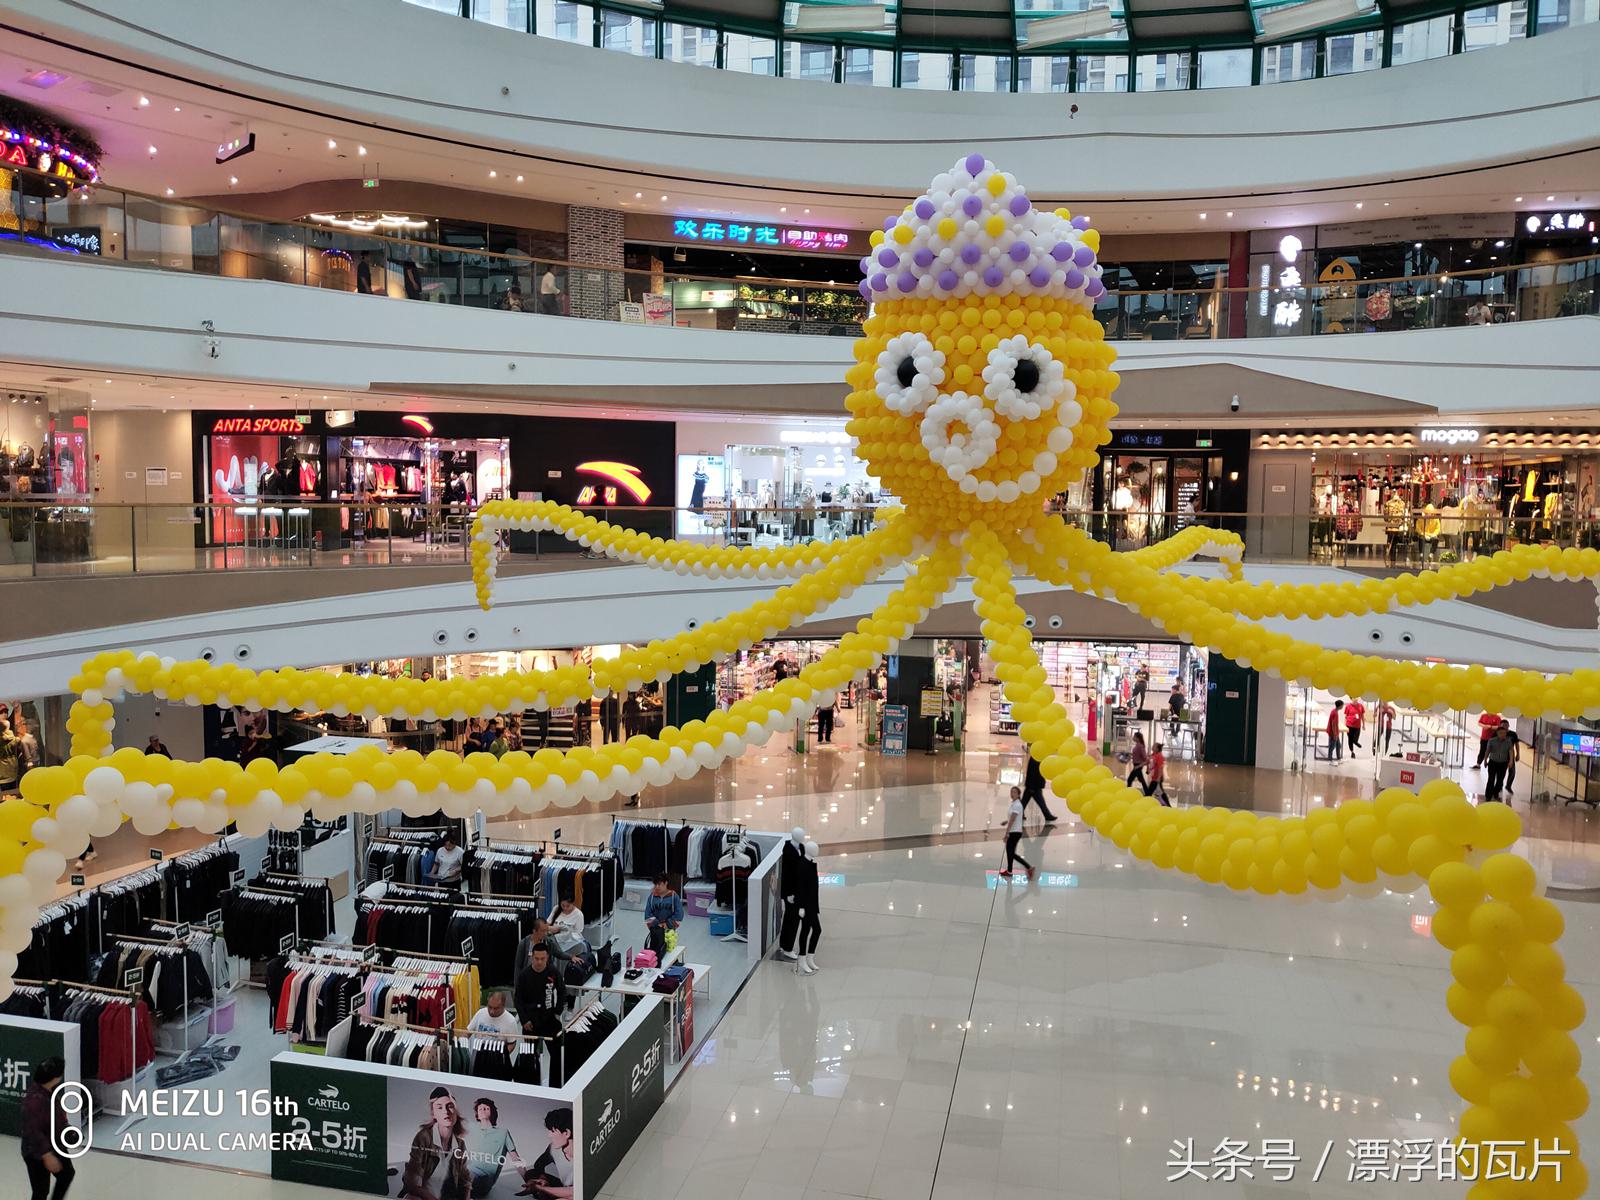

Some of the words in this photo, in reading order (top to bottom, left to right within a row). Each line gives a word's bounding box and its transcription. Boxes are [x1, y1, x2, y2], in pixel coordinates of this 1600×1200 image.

[673, 219, 780, 244] 欢乐时光
[213, 418, 252, 433] ANTA
[252, 418, 304, 433] SPORTS
[1421, 429, 1479, 445] mogao
[0, 1057, 30, 1090] 折
[631, 1038, 661, 1093] 2-5折
[307, 1096, 350, 1111] CARTELO
[291, 1116, 368, 1153] 2-5折
[589, 1109, 621, 1155] CARTELO
[453, 1148, 507, 1166] CARTELO
